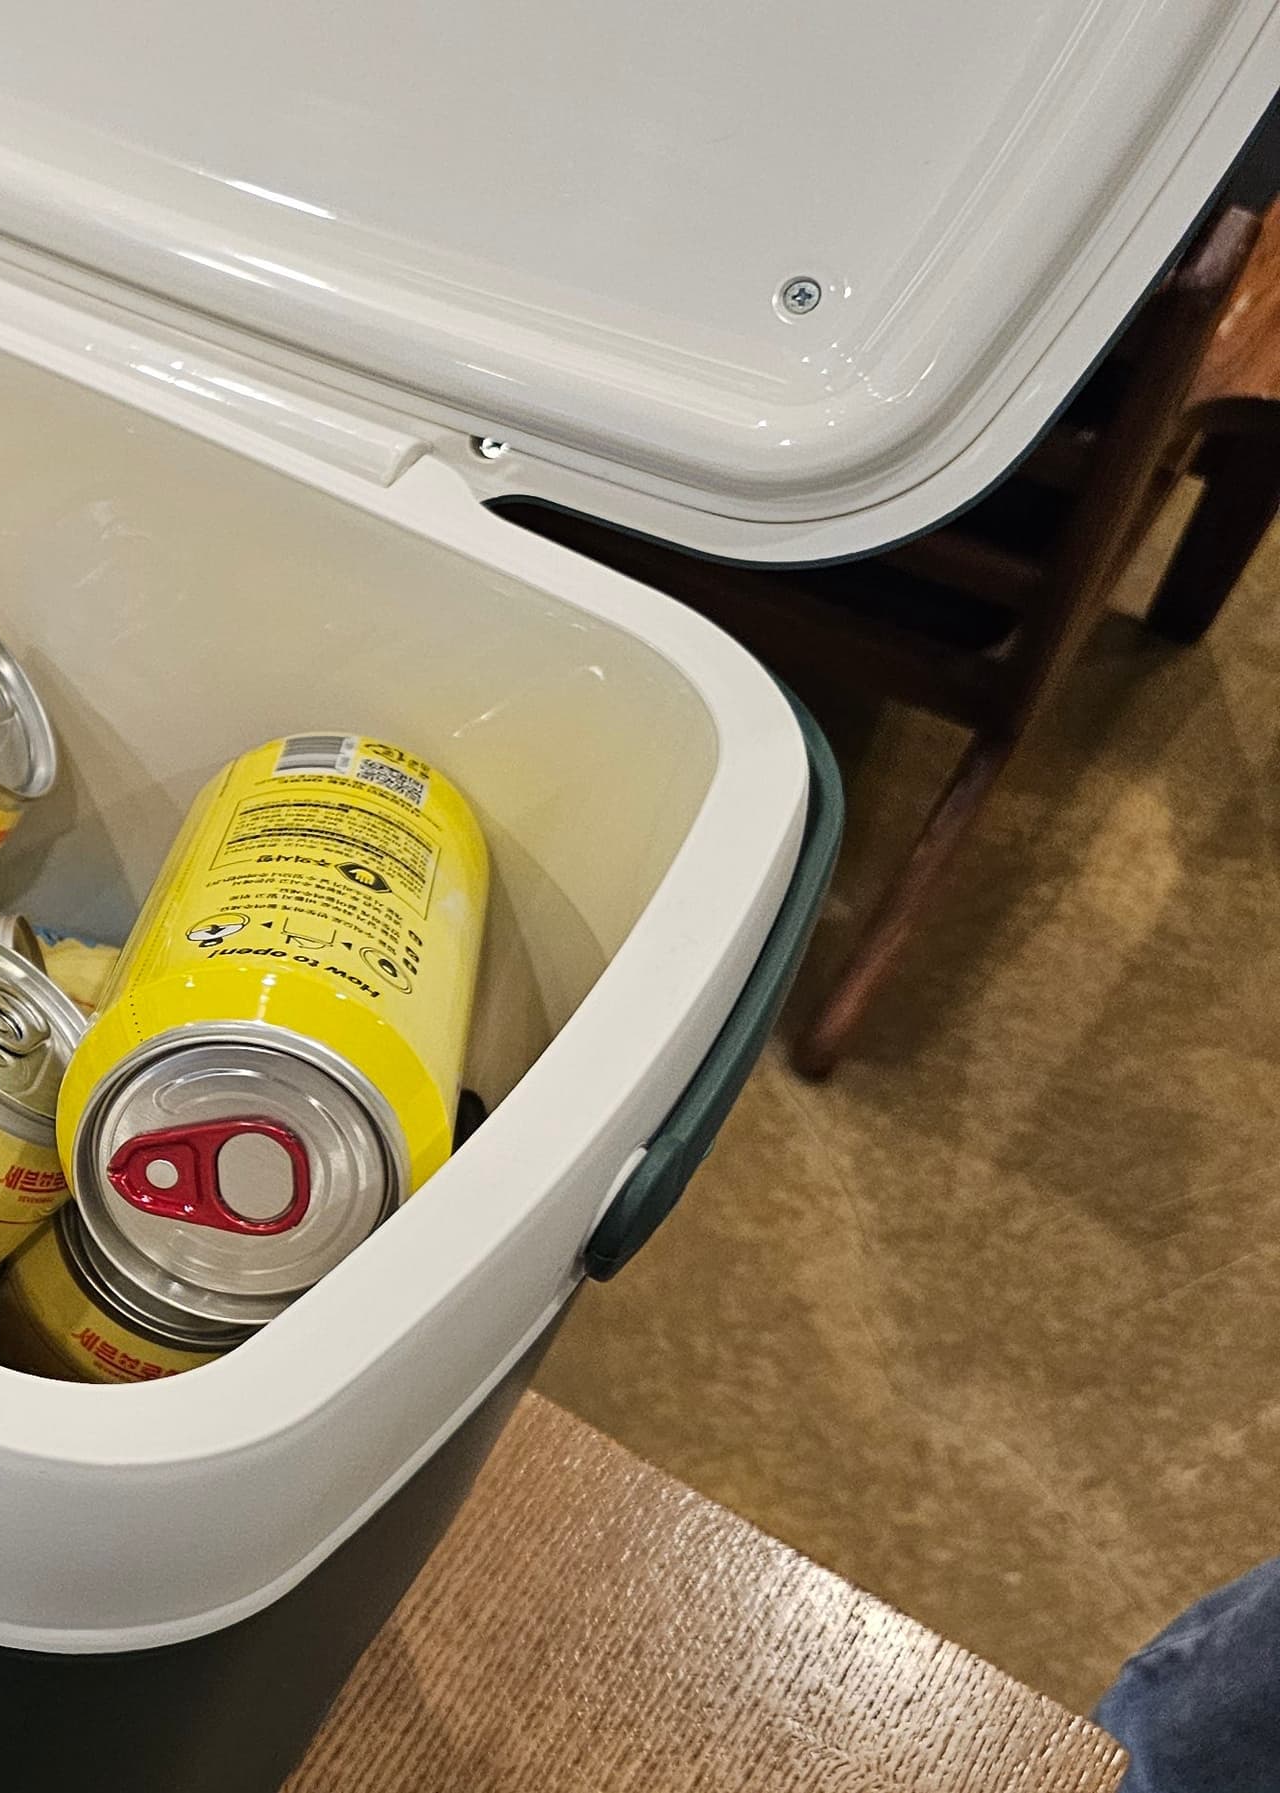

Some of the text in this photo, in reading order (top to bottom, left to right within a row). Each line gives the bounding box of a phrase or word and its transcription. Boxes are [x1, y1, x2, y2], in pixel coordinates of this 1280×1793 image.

[256, 853, 333, 869] 주의사항
[206, 947, 381, 998] How to open!
